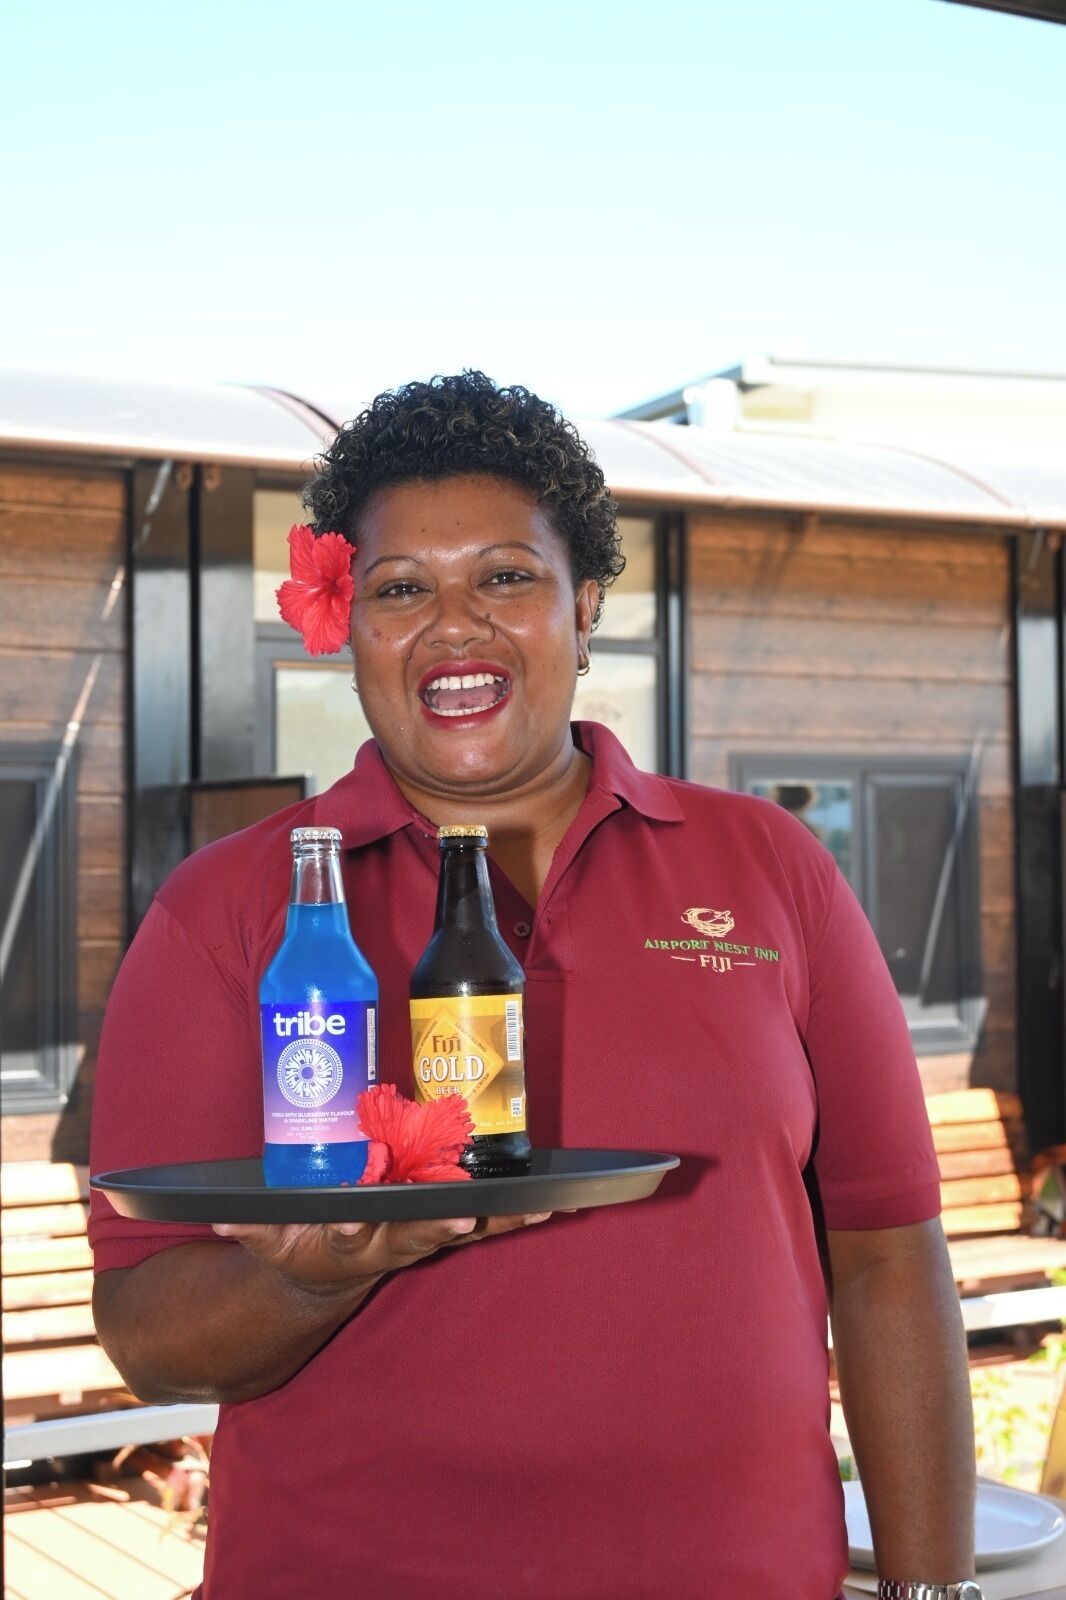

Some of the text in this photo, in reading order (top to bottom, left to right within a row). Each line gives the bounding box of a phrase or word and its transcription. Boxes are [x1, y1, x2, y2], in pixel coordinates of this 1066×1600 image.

[644, 939, 779, 961] AIRPORT NEST INN
[699, 954, 733, 973] FIJI
[273, 1012, 346, 1037] tribe
[420, 1055, 485, 1083] GOLD
[435, 1085, 463, 1096] BEER
